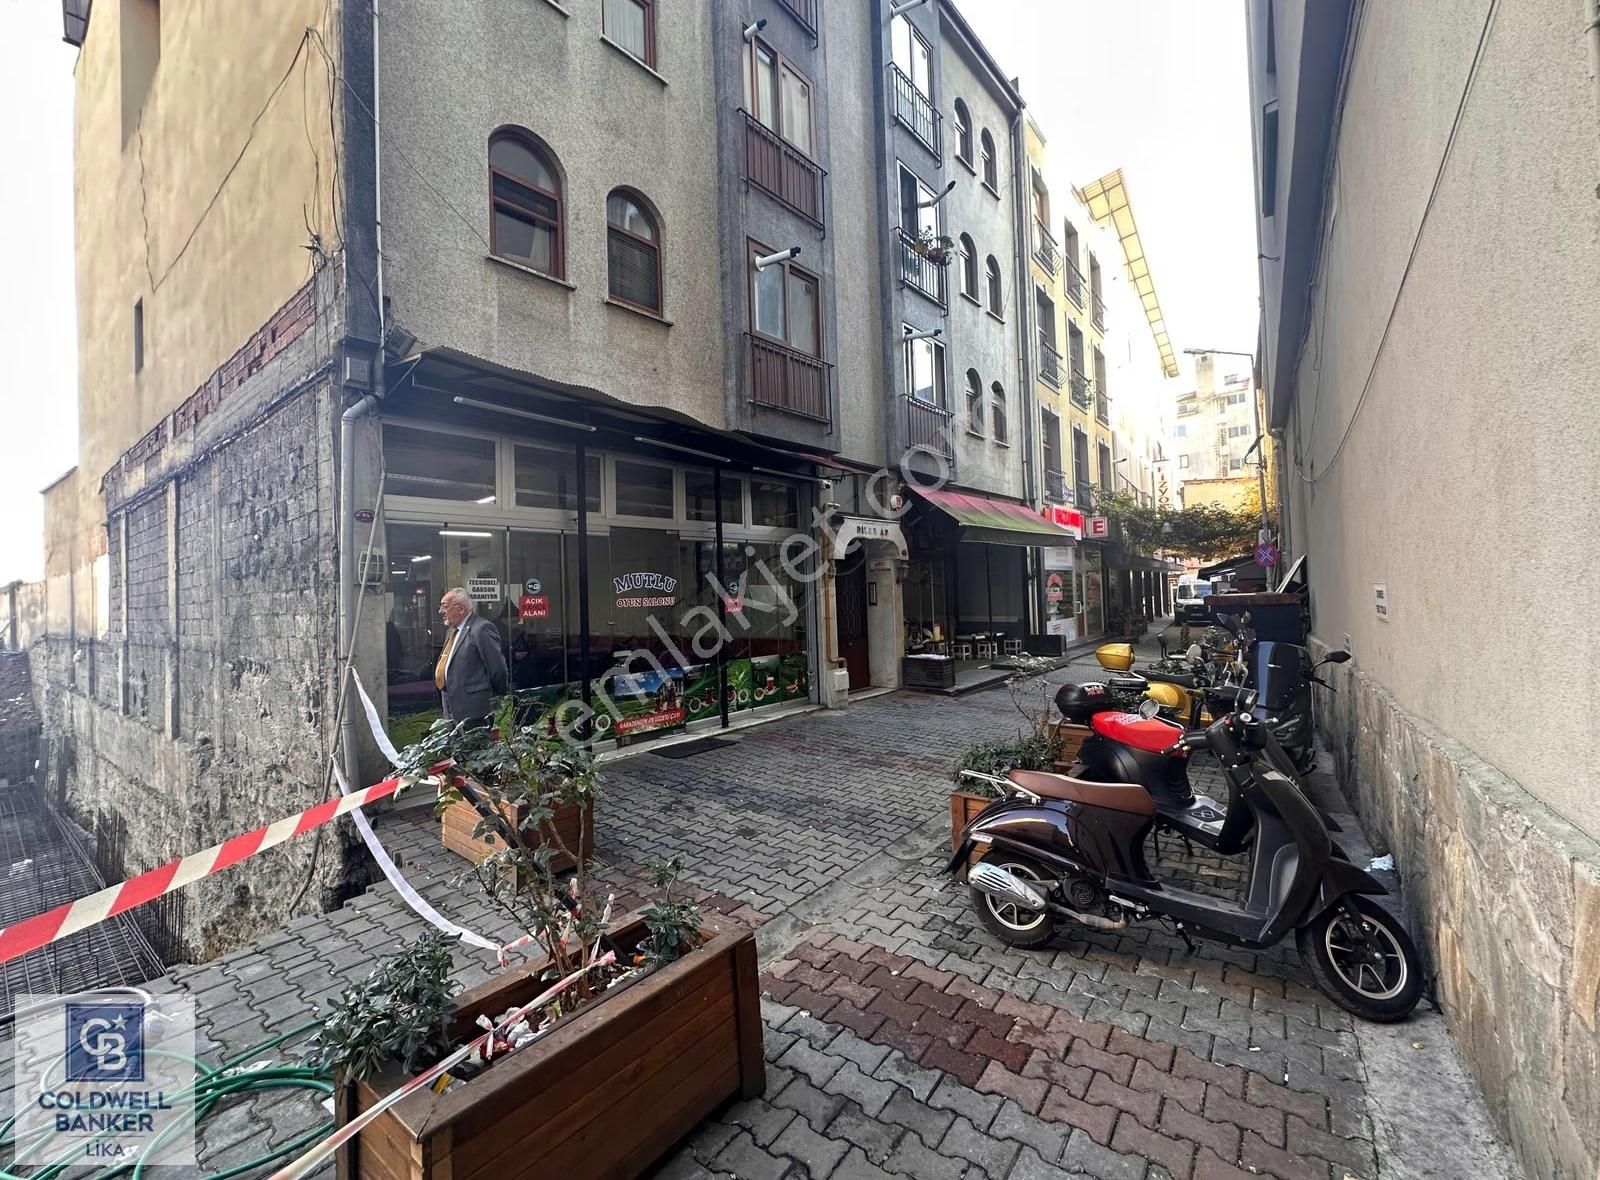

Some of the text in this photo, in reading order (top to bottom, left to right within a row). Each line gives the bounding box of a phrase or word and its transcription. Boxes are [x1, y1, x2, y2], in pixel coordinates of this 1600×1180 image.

[1092, 520, 1105, 535] E
[613, 572, 677, 594] MUTLU
[616, 597, 676, 608] OYUN SALONU
